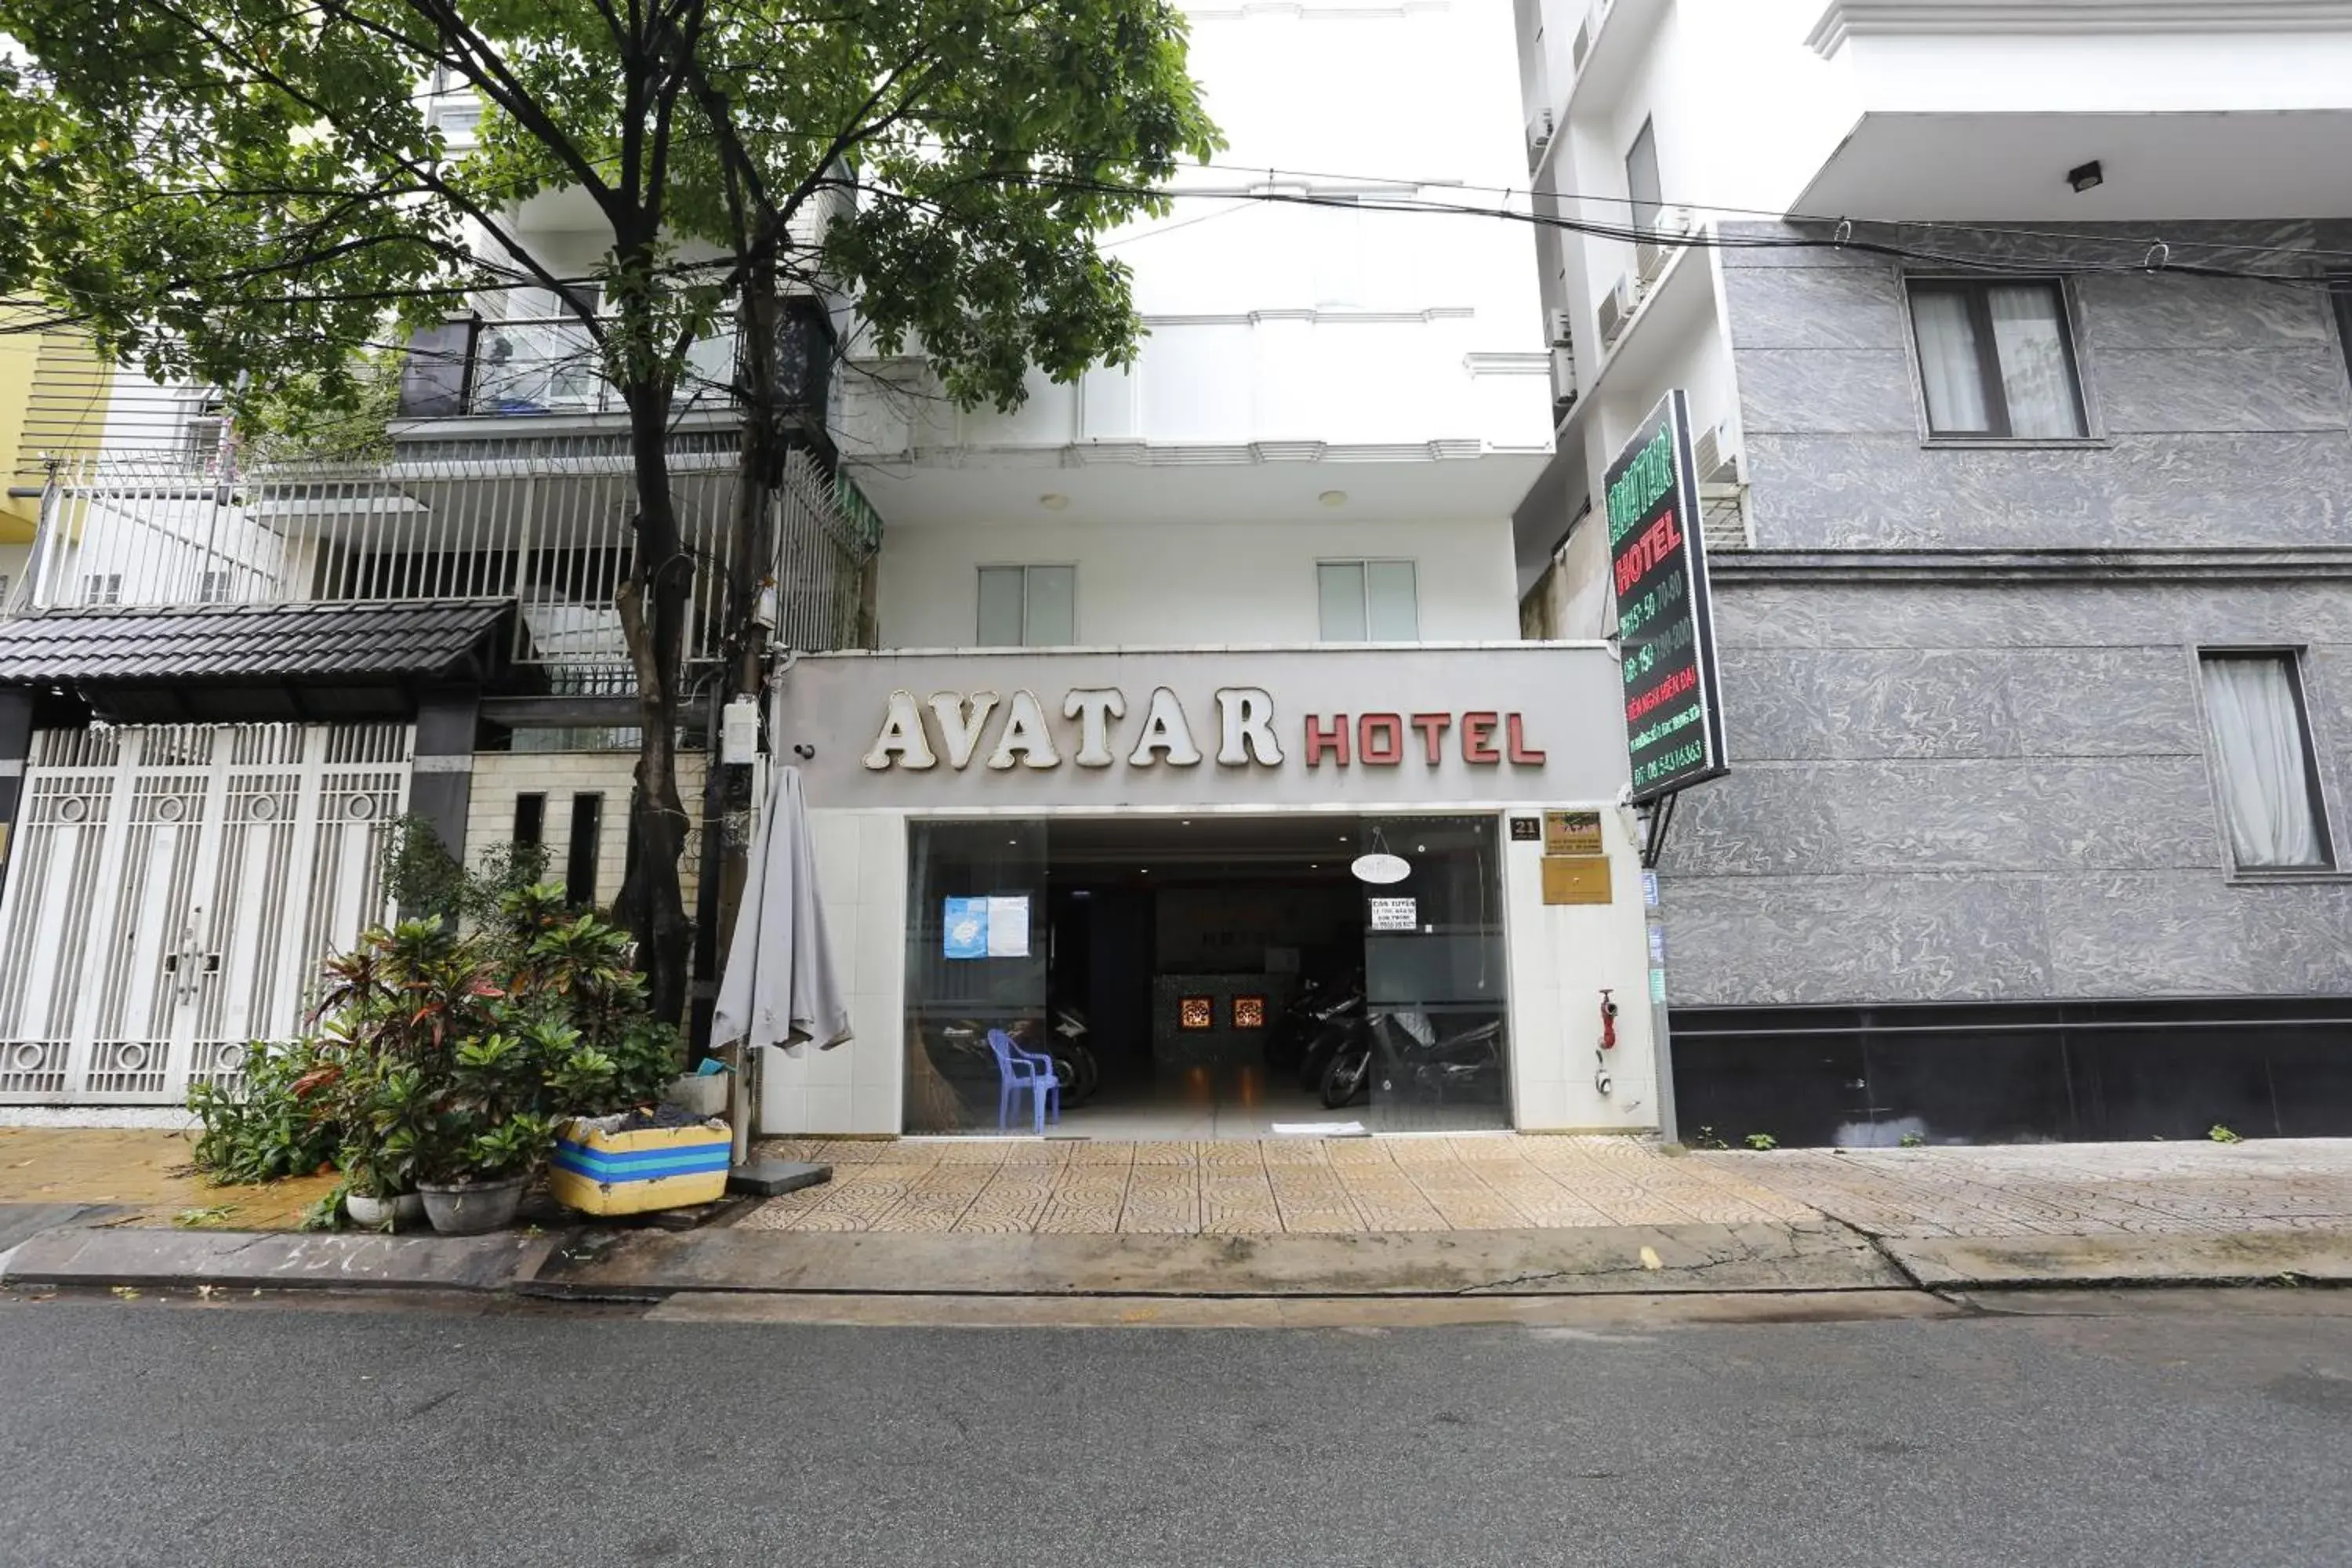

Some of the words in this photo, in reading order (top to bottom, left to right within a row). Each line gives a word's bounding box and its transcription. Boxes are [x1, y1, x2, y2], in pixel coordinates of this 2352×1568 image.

[1615, 510, 1682, 597] HOTEL
[863, 685, 1284, 771] AVATAR
[1305, 710, 1546, 768] HOTEL
[1515, 821, 1537, 833] 21
